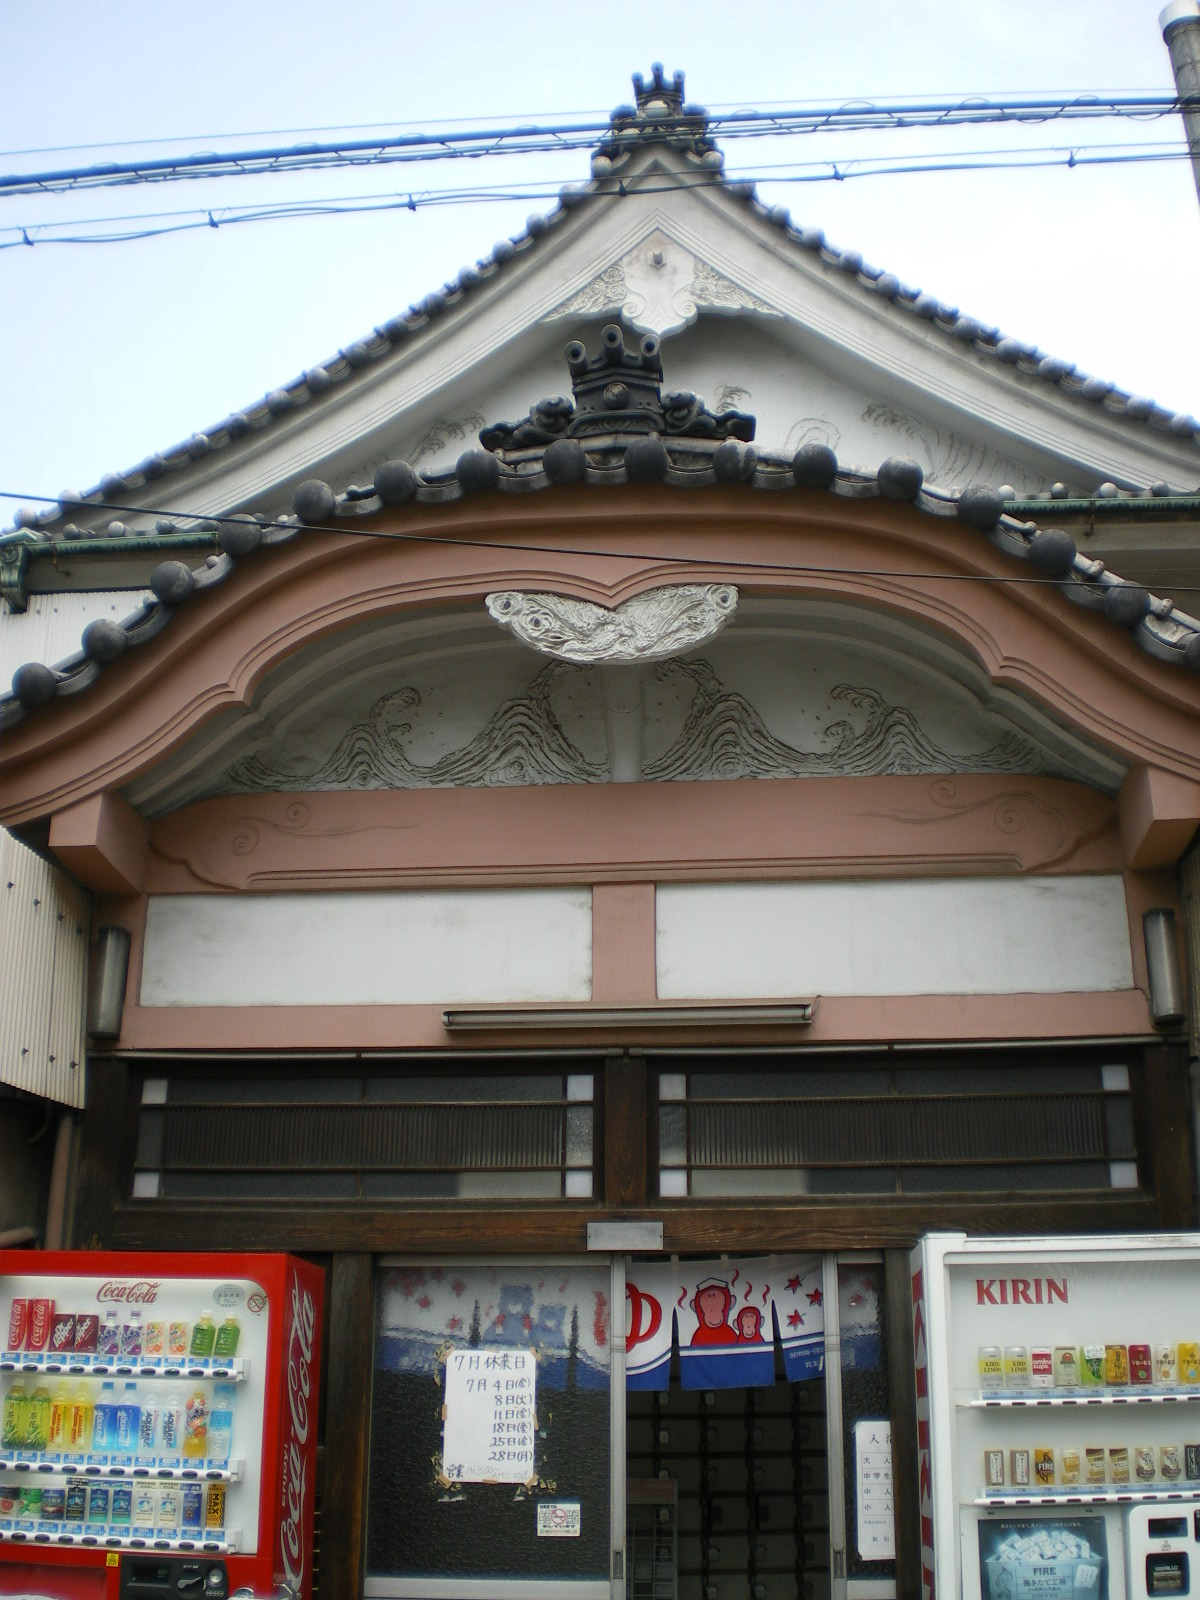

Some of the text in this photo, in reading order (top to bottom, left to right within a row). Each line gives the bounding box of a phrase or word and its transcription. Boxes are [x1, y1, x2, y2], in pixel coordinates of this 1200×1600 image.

[97, 1281, 162, 1303] Coca-Cola
[976, 1279, 1069, 1305] KIRIN
[212, 1493, 220, 1515] MAX
[1033, 1567, 1056, 1575] FIRE
